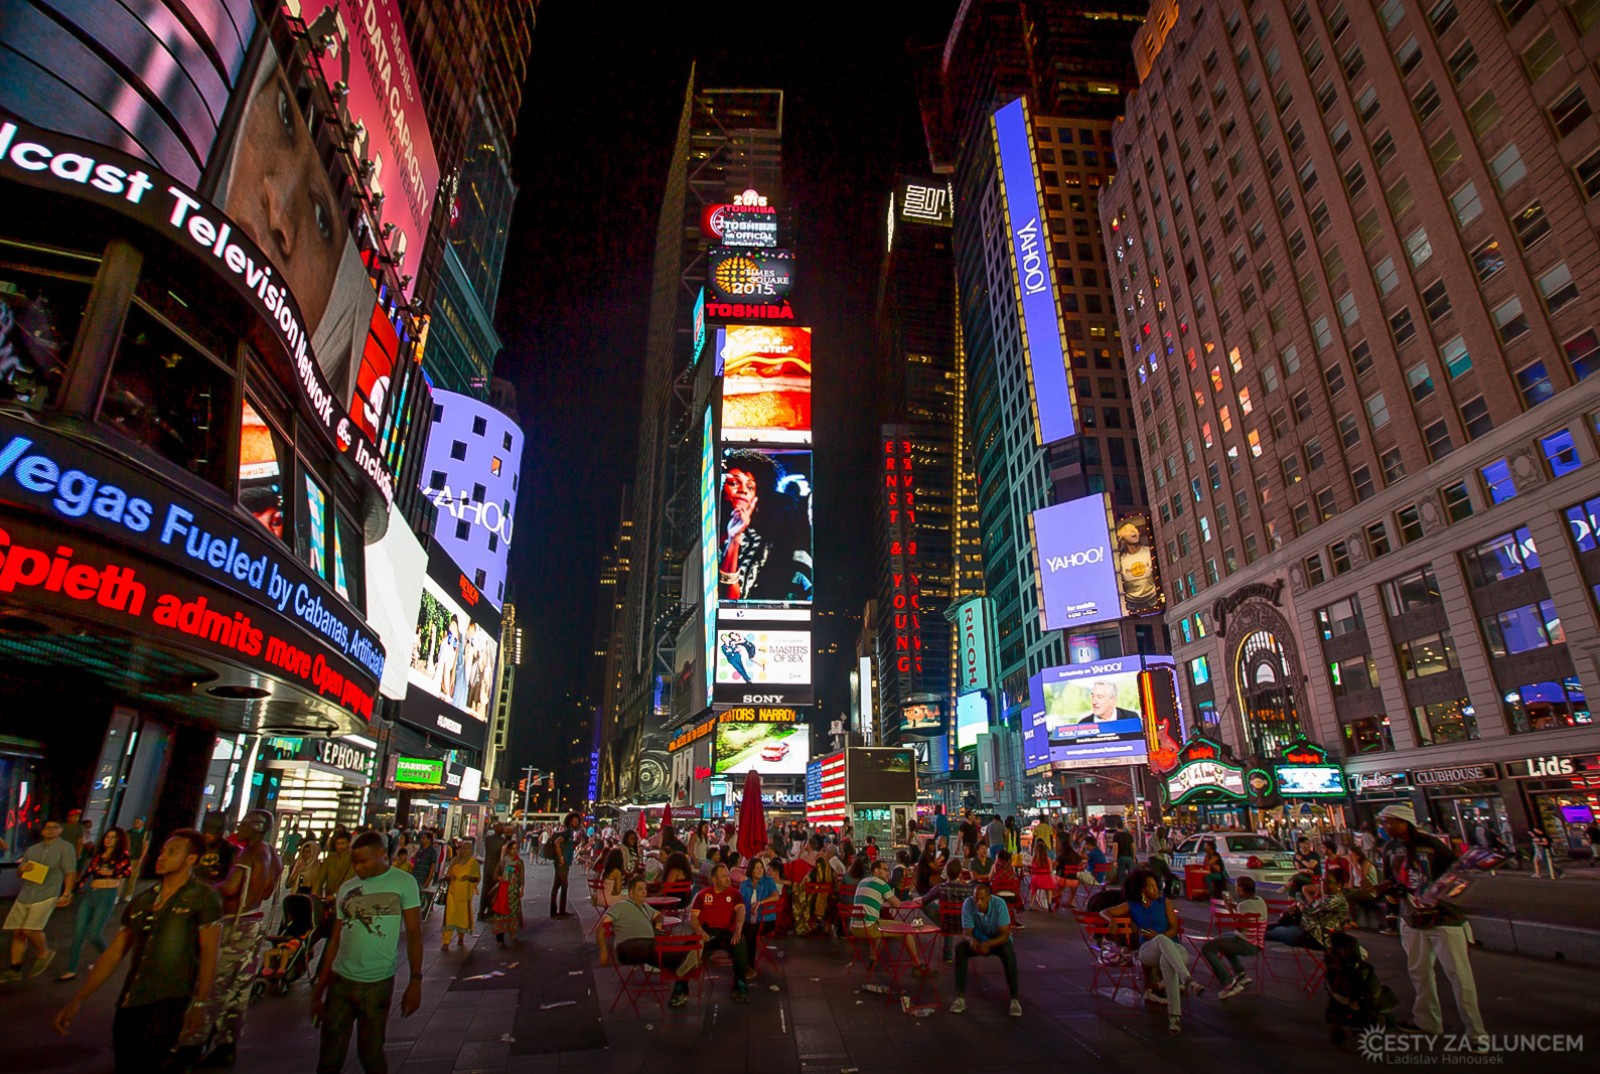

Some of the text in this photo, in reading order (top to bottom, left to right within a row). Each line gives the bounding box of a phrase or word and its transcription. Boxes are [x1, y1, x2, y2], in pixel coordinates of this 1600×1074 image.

[364, 0, 429, 217] DATA CAPACITY
[724, 204, 776, 214] TOSHIBA
[1016, 217, 1047, 297] YAHOO!
[744, 269, 775, 278] TIMES
[749, 276, 790, 285] SQUARE
[168, 186, 299, 349] Television
[294, 332, 335, 427] Network
[705, 303, 795, 319] TOSHIBA
[884, 441, 911, 673] ERNST & YOUNG
[1046, 546, 1104, 573] YAHOO!
[160, 504, 268, 590] Fueled
[267, 565, 294, 611] by
[294, 583, 349, 655] Cabanas,
[153, 593, 263, 656] admits
[265, 636, 312, 679] more
[311, 653, 344, 697] Open
[768, 645, 809, 655] MASTERS
[963, 607, 978, 685] RICOH
[773, 654, 805, 663] OF SEX
[1090, 661, 1123, 674] YAHOO!
[742, 694, 784, 704] SONY
[317, 739, 366, 773] SEPHORA
[402, 769, 431, 779] COFFEE
[1417, 767, 1484, 784] CLUBHOUSE
[1526, 756, 1574, 777] Lids
[1352, 771, 1393, 796] Yankees
[776, 790, 804, 803] POLICE
